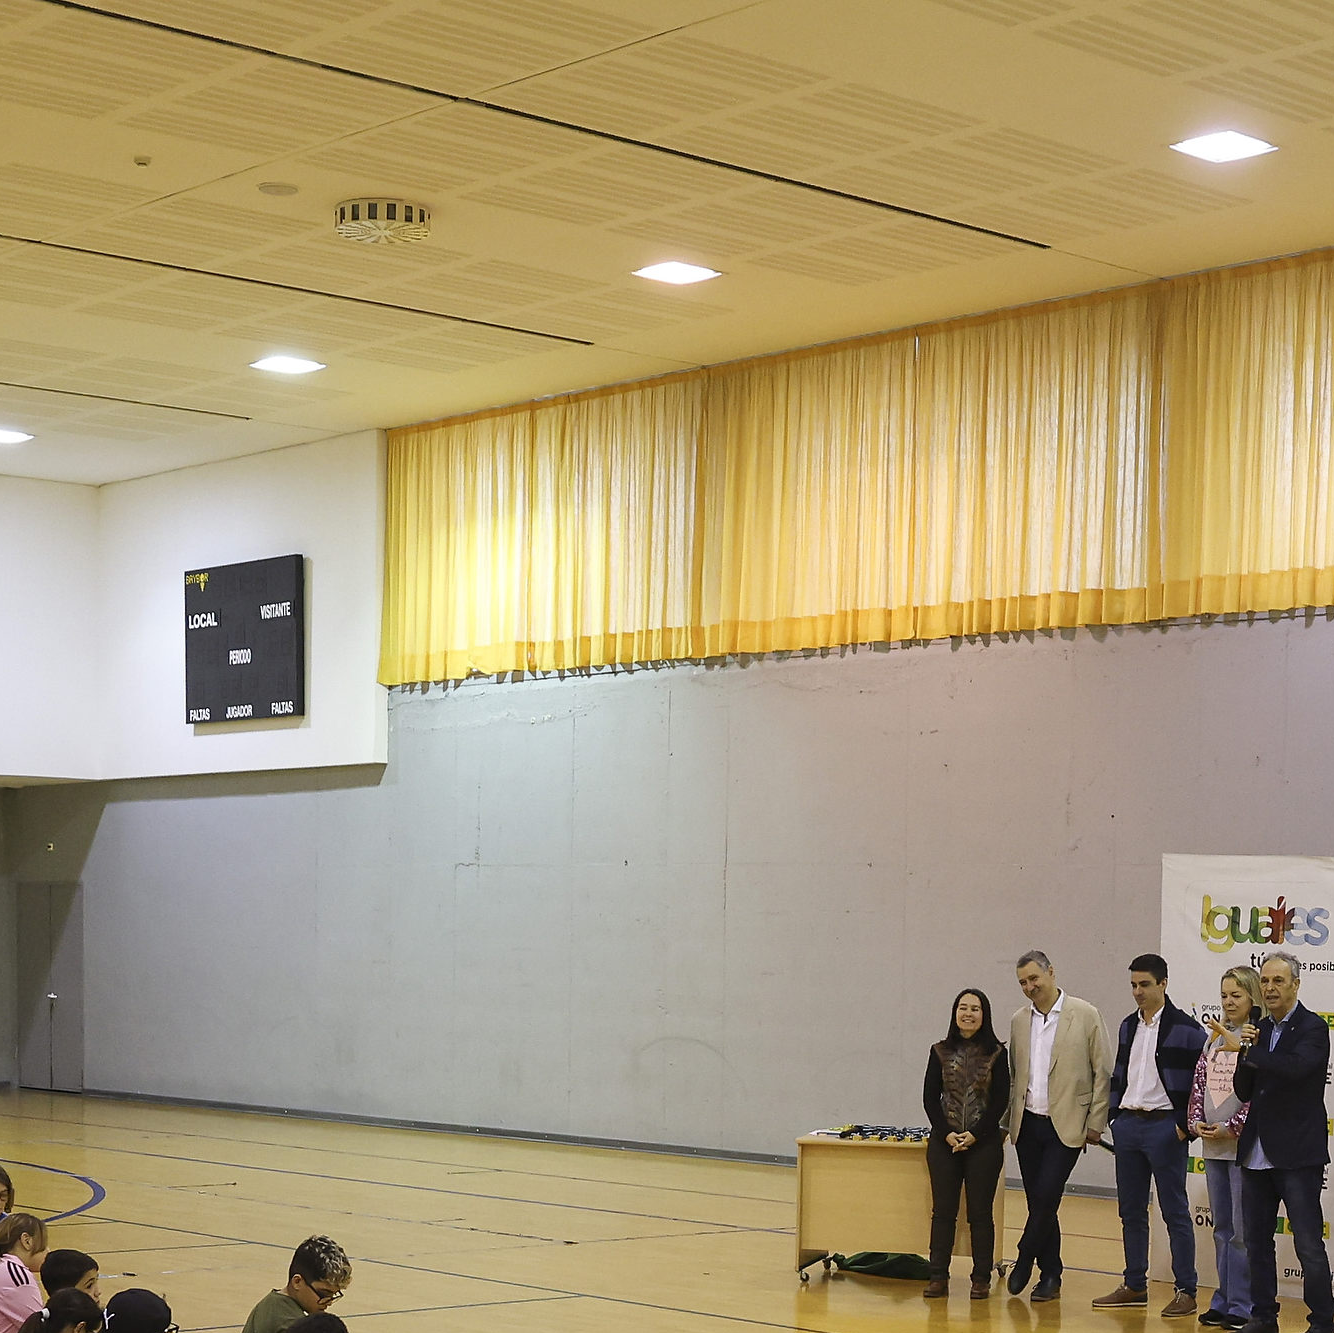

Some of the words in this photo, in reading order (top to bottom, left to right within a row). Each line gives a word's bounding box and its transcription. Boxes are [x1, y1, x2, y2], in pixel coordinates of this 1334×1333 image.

[260, 602, 291, 620] VISITANTE
[189, 612, 218, 629] LOCAL
[229, 649, 252, 666] PERIODO
[189, 708, 210, 722] FALTAS
[226, 705, 253, 719] JUGADOR
[271, 701, 294, 715] FALTAS
[1201, 894, 1329, 953] Iguales
[1202, 1013, 1221, 1024] ON
[1195, 1215, 1214, 1228] ON
